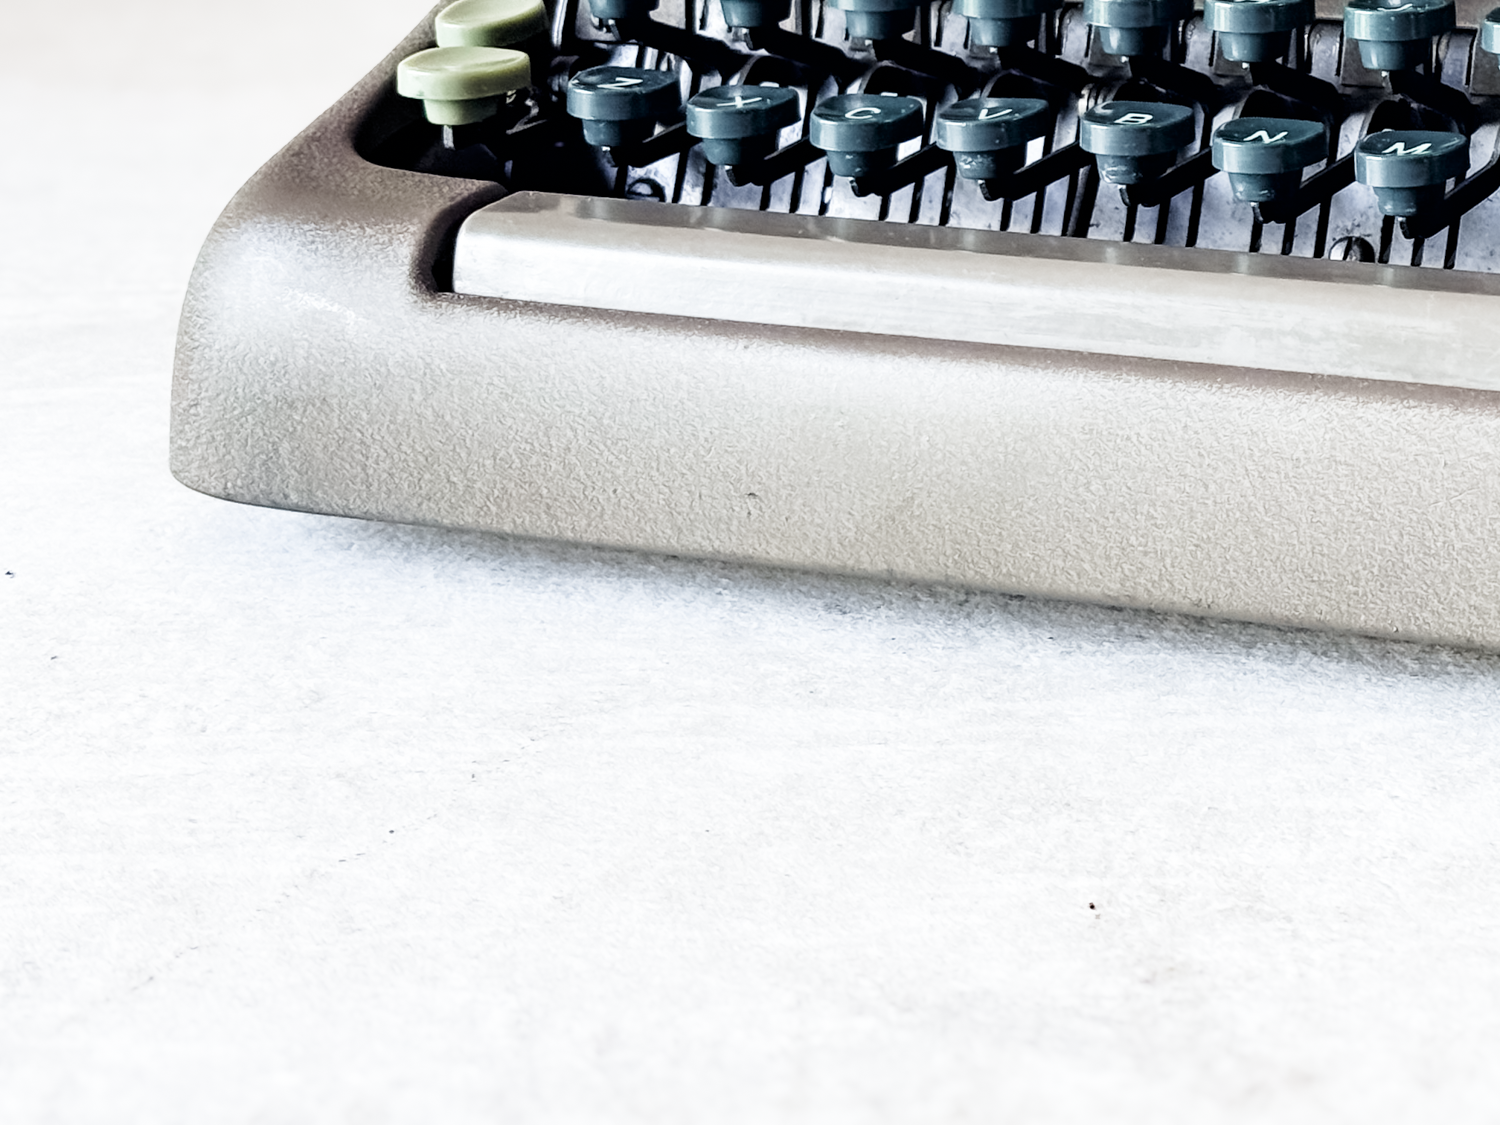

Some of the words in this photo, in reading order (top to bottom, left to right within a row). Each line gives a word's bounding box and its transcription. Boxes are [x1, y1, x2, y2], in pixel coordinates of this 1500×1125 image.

[596, 77, 644, 89] Z
[716, 95, 763, 109] X
[844, 107, 882, 120] C
[978, 108, 1013, 121] V
[1113, 113, 1154, 125] B
[1242, 130, 1289, 144] N
[1381, 141, 1433, 156] M
